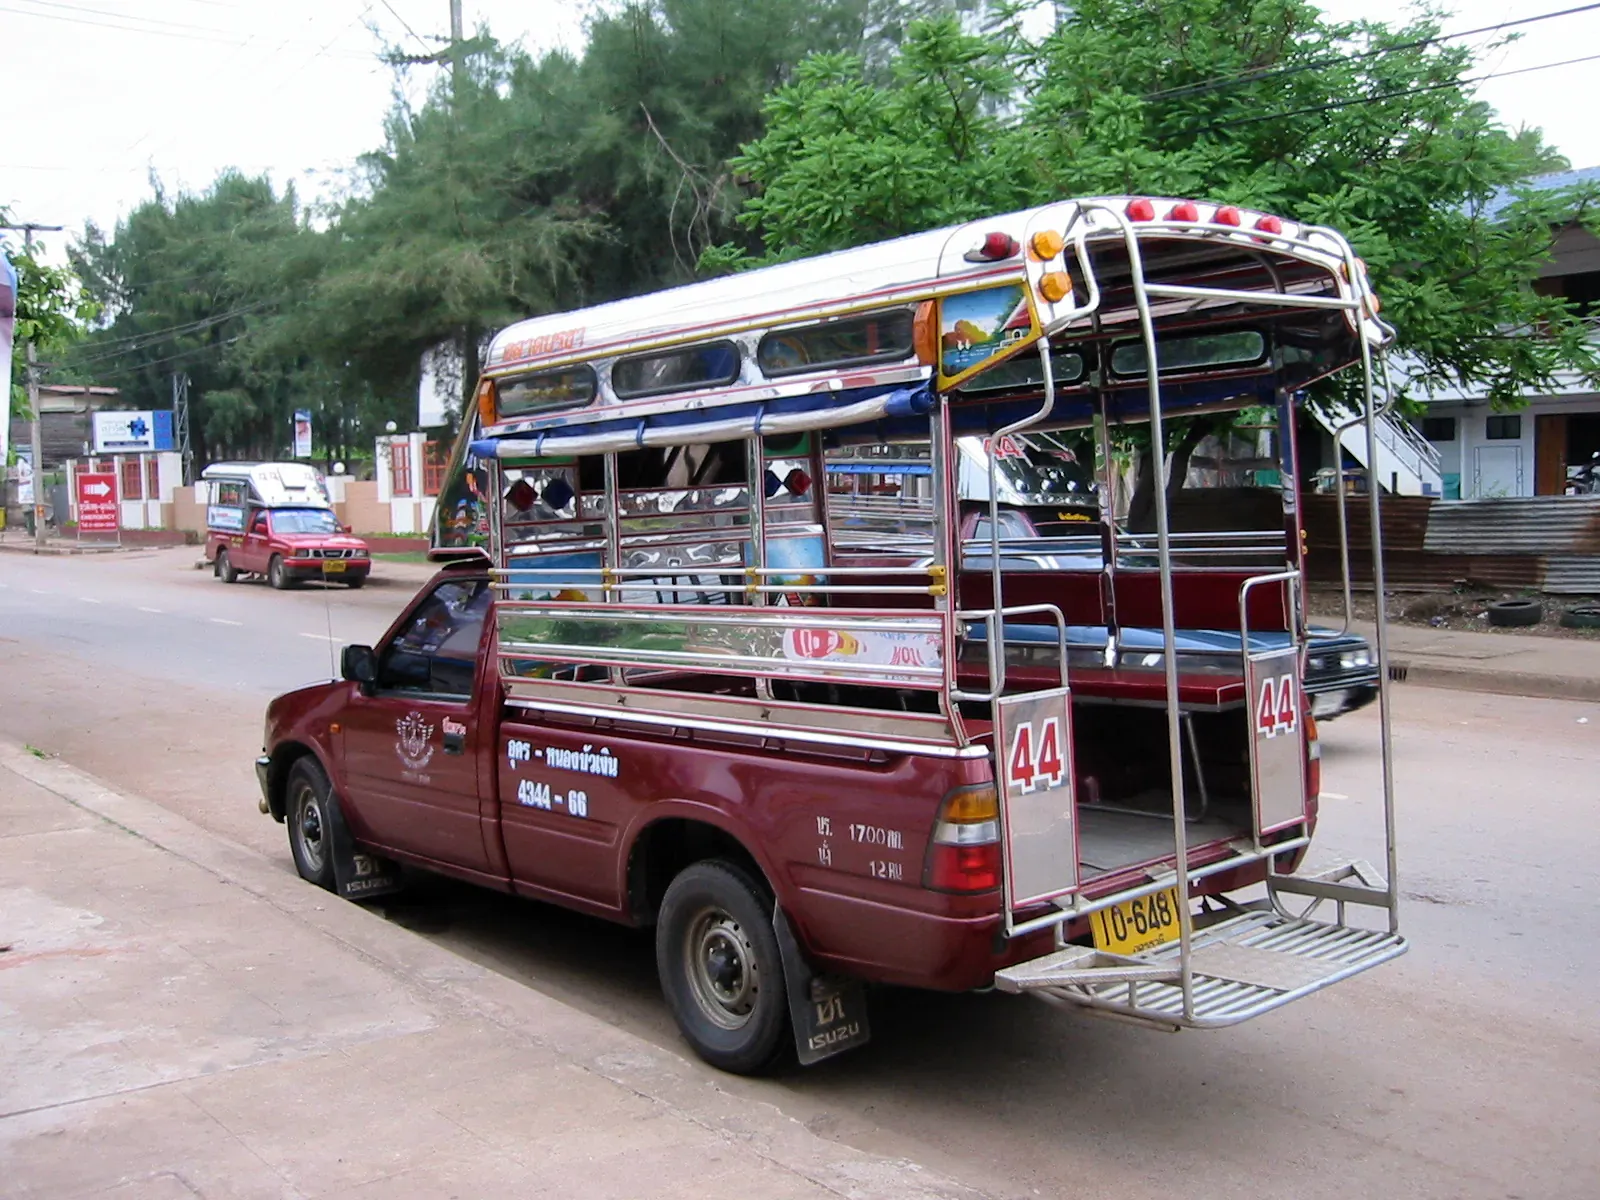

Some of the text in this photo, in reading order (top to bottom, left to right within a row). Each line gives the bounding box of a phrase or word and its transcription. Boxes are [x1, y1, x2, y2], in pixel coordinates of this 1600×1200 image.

[1257, 674, 1296, 738] 44
[1009, 717, 1064, 794] 44
[517, 779, 551, 810] 4344
[568, 790, 588, 817] 66
[808, 1021, 860, 1049] ISUZU
